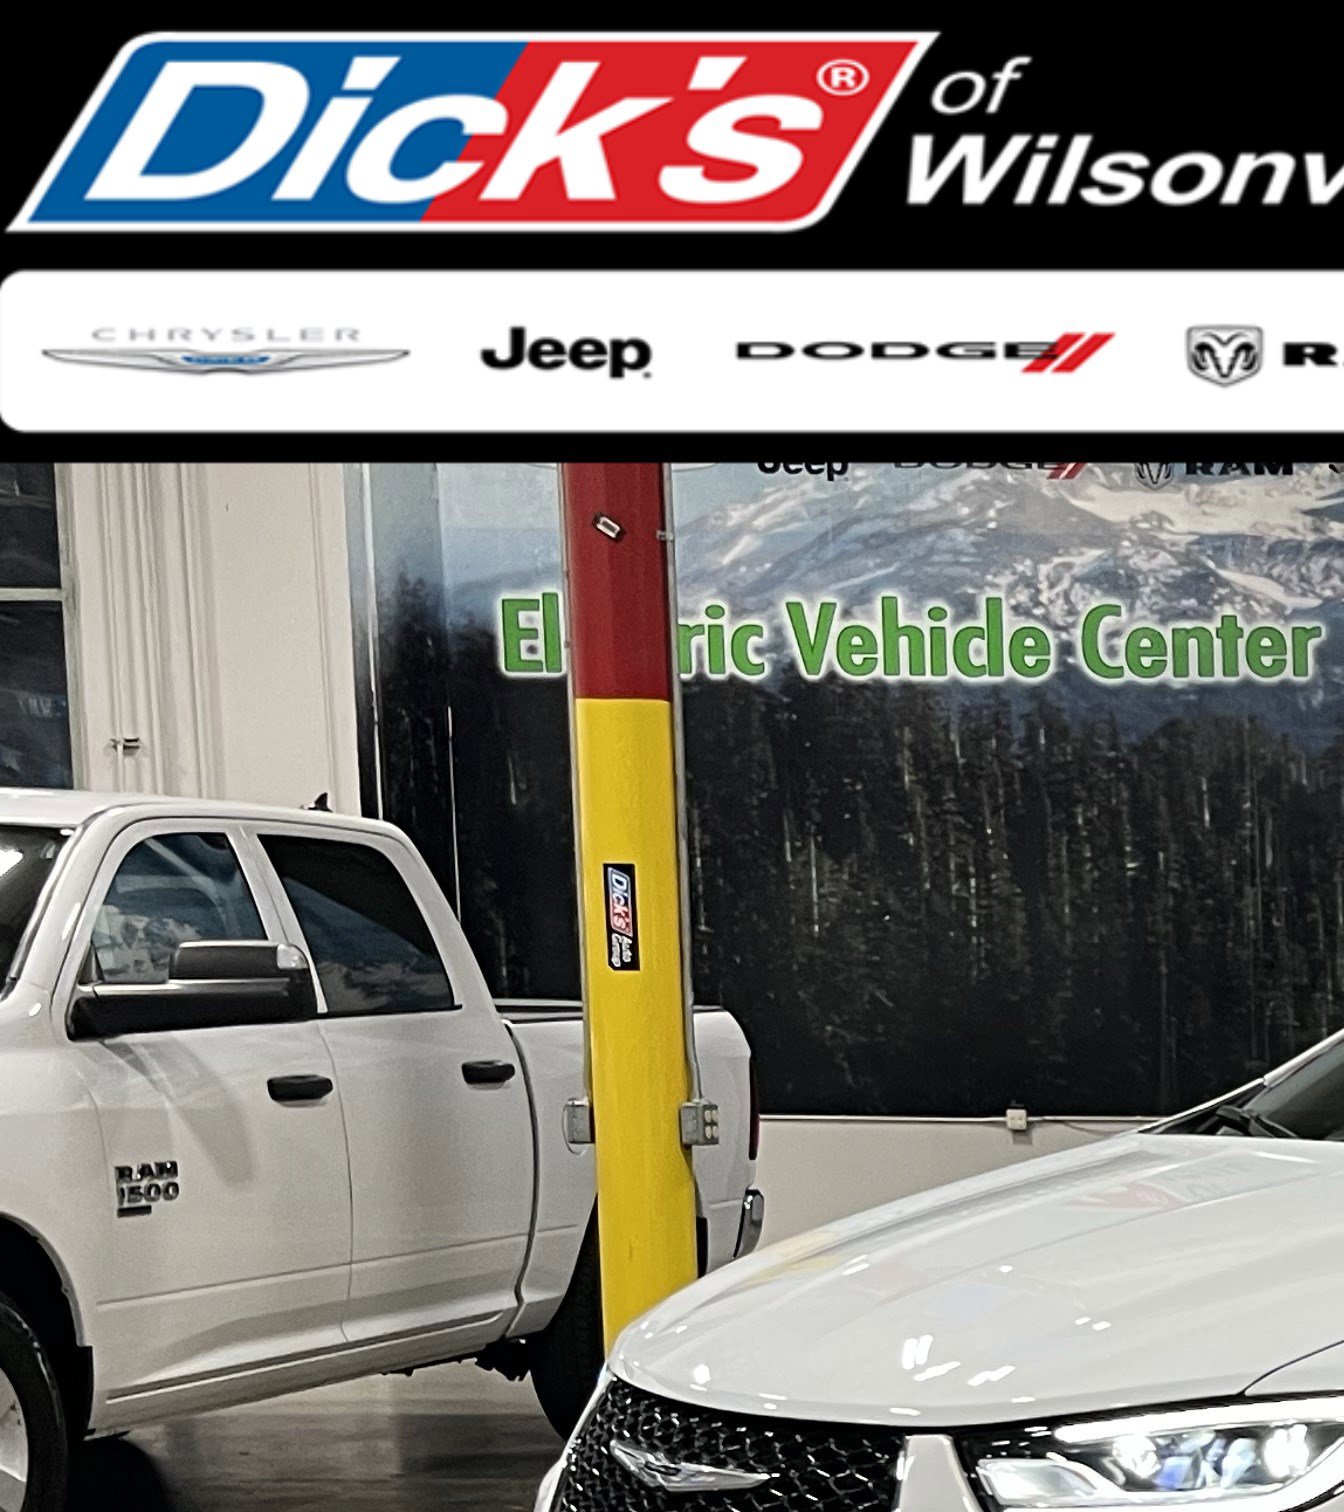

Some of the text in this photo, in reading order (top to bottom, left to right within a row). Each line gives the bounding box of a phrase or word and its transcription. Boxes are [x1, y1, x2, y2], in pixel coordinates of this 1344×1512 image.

[502, 592, 1323, 679] Elric Vehicle Center
[610, 872, 630, 931] Dick's
[115, 1160, 179, 1182] RAM
[117, 1181, 180, 1206] 1500
